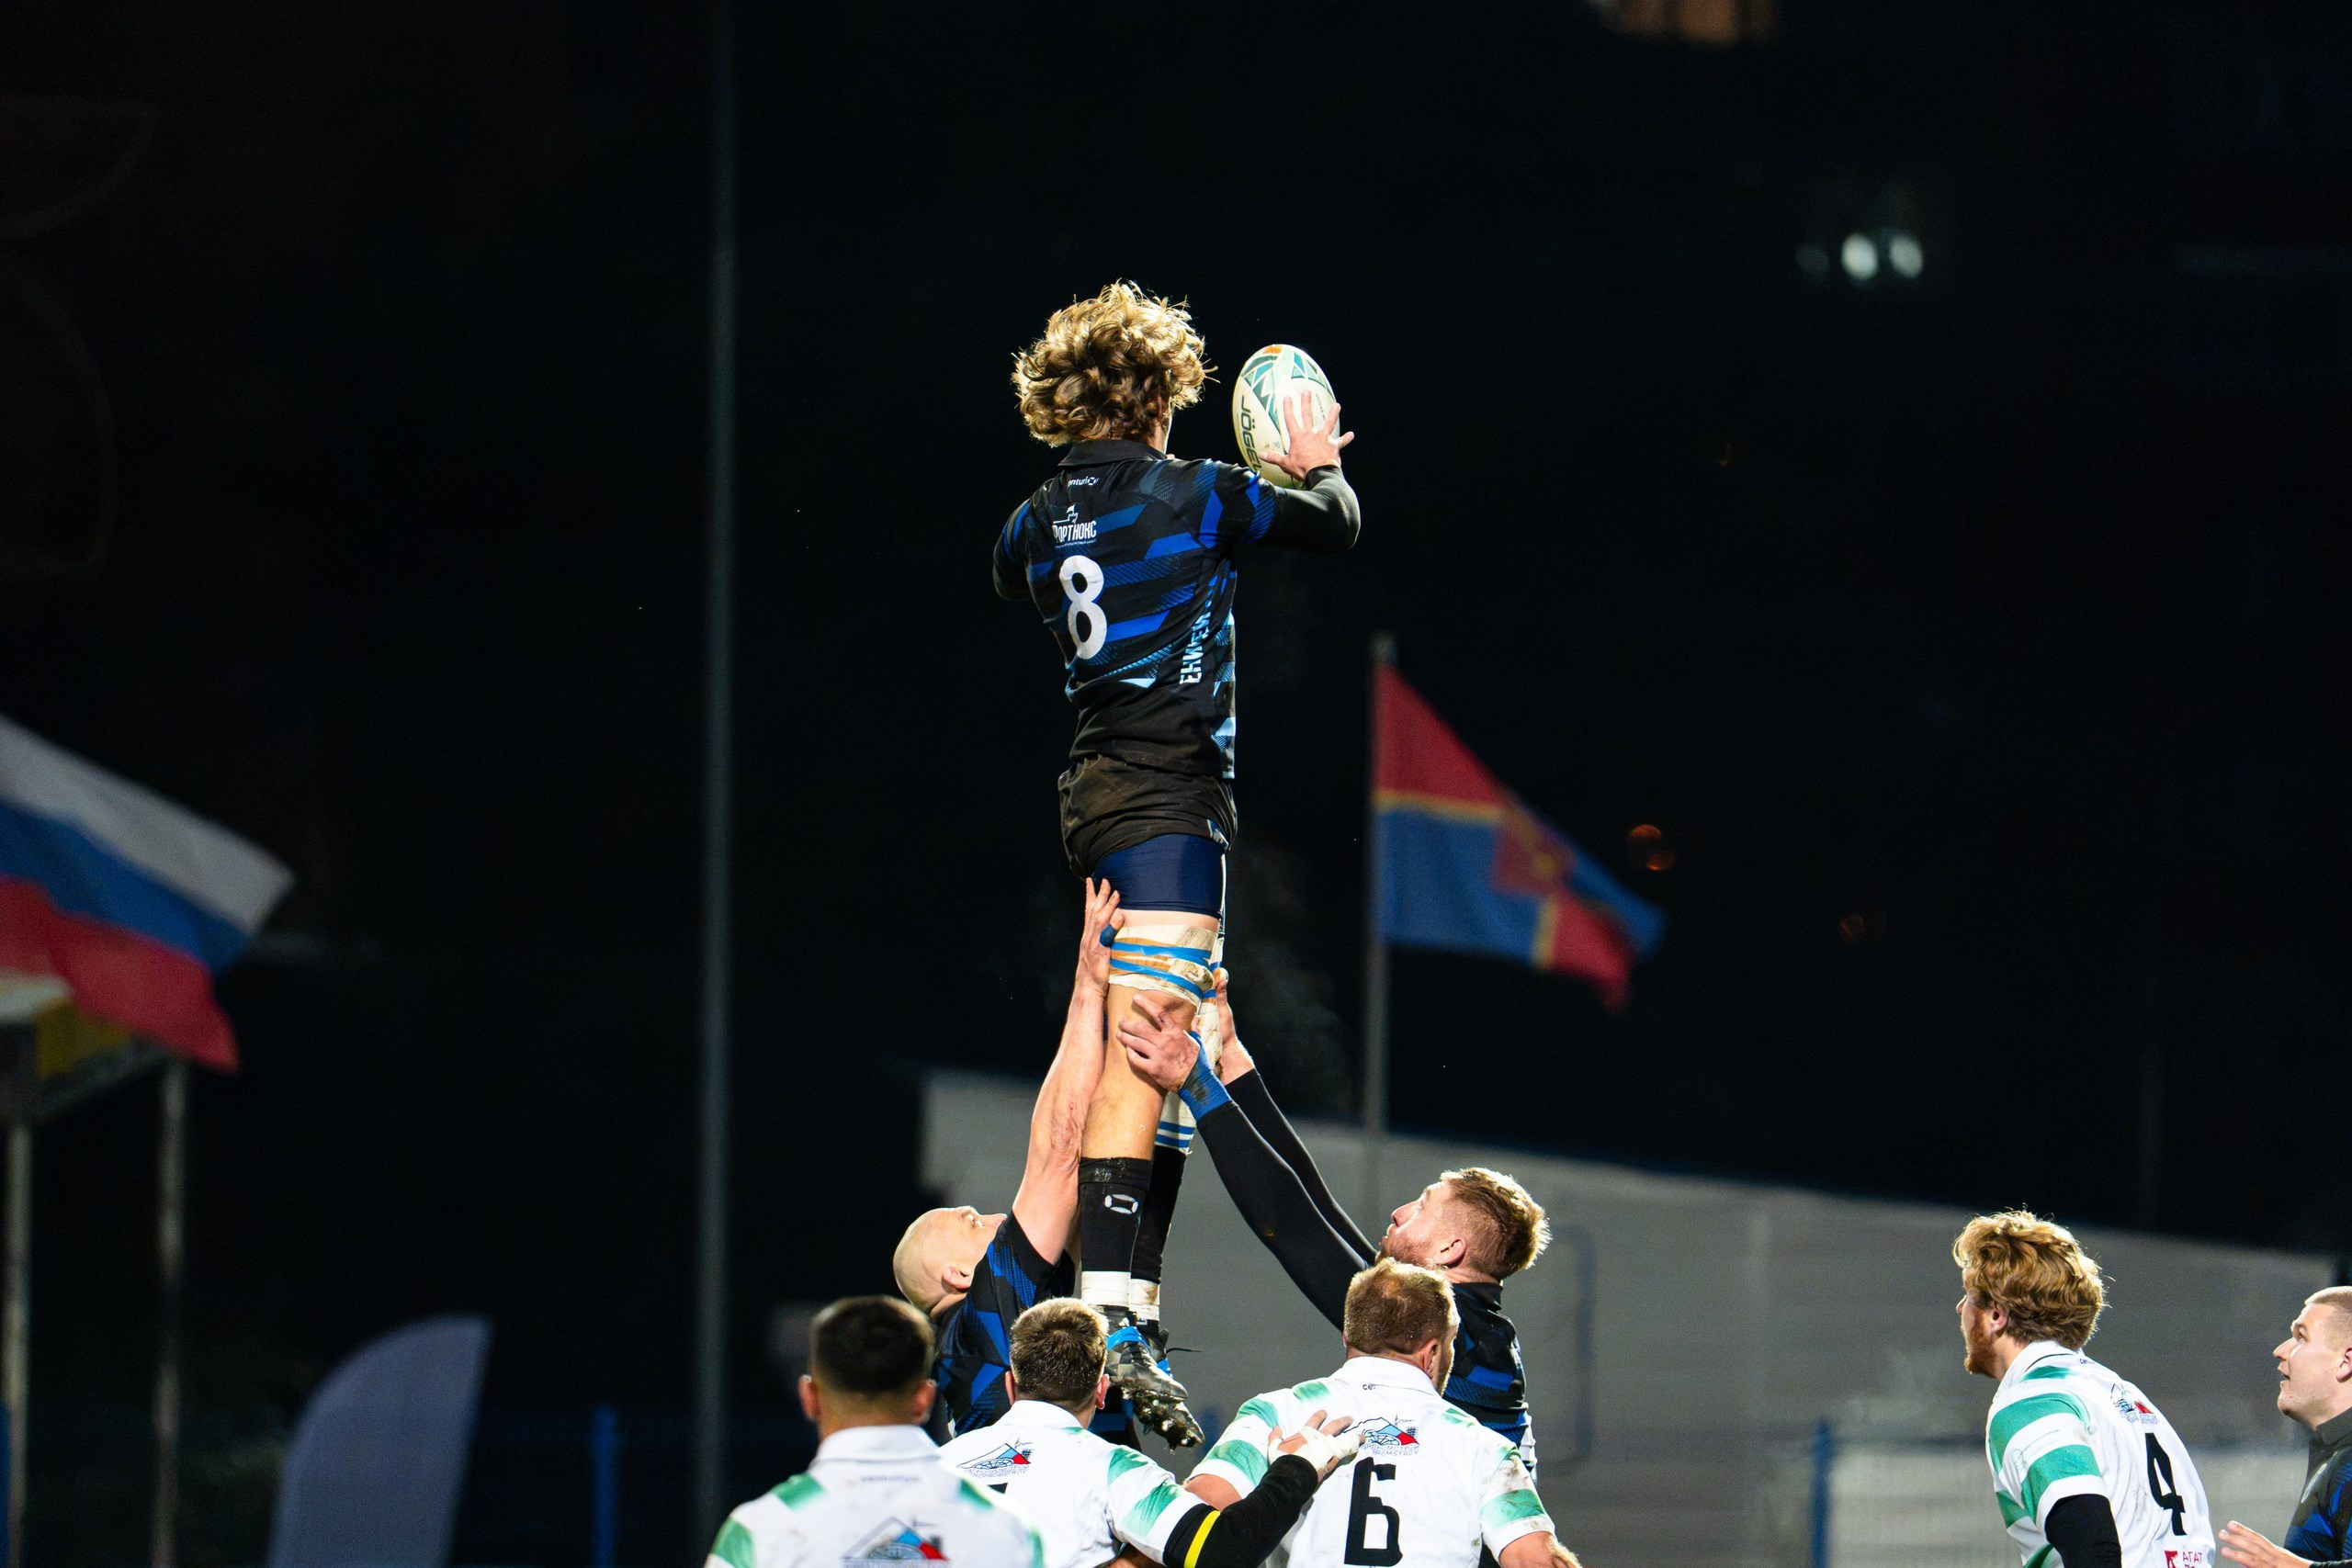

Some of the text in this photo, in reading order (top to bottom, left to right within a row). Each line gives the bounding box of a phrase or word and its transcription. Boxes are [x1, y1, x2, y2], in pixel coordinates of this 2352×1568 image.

[1241, 395, 1261, 470] JÖGEL
[1059, 555, 1107, 660] 8
[1344, 1456, 1404, 1567] 6
[2145, 1432, 2187, 1536] 4
